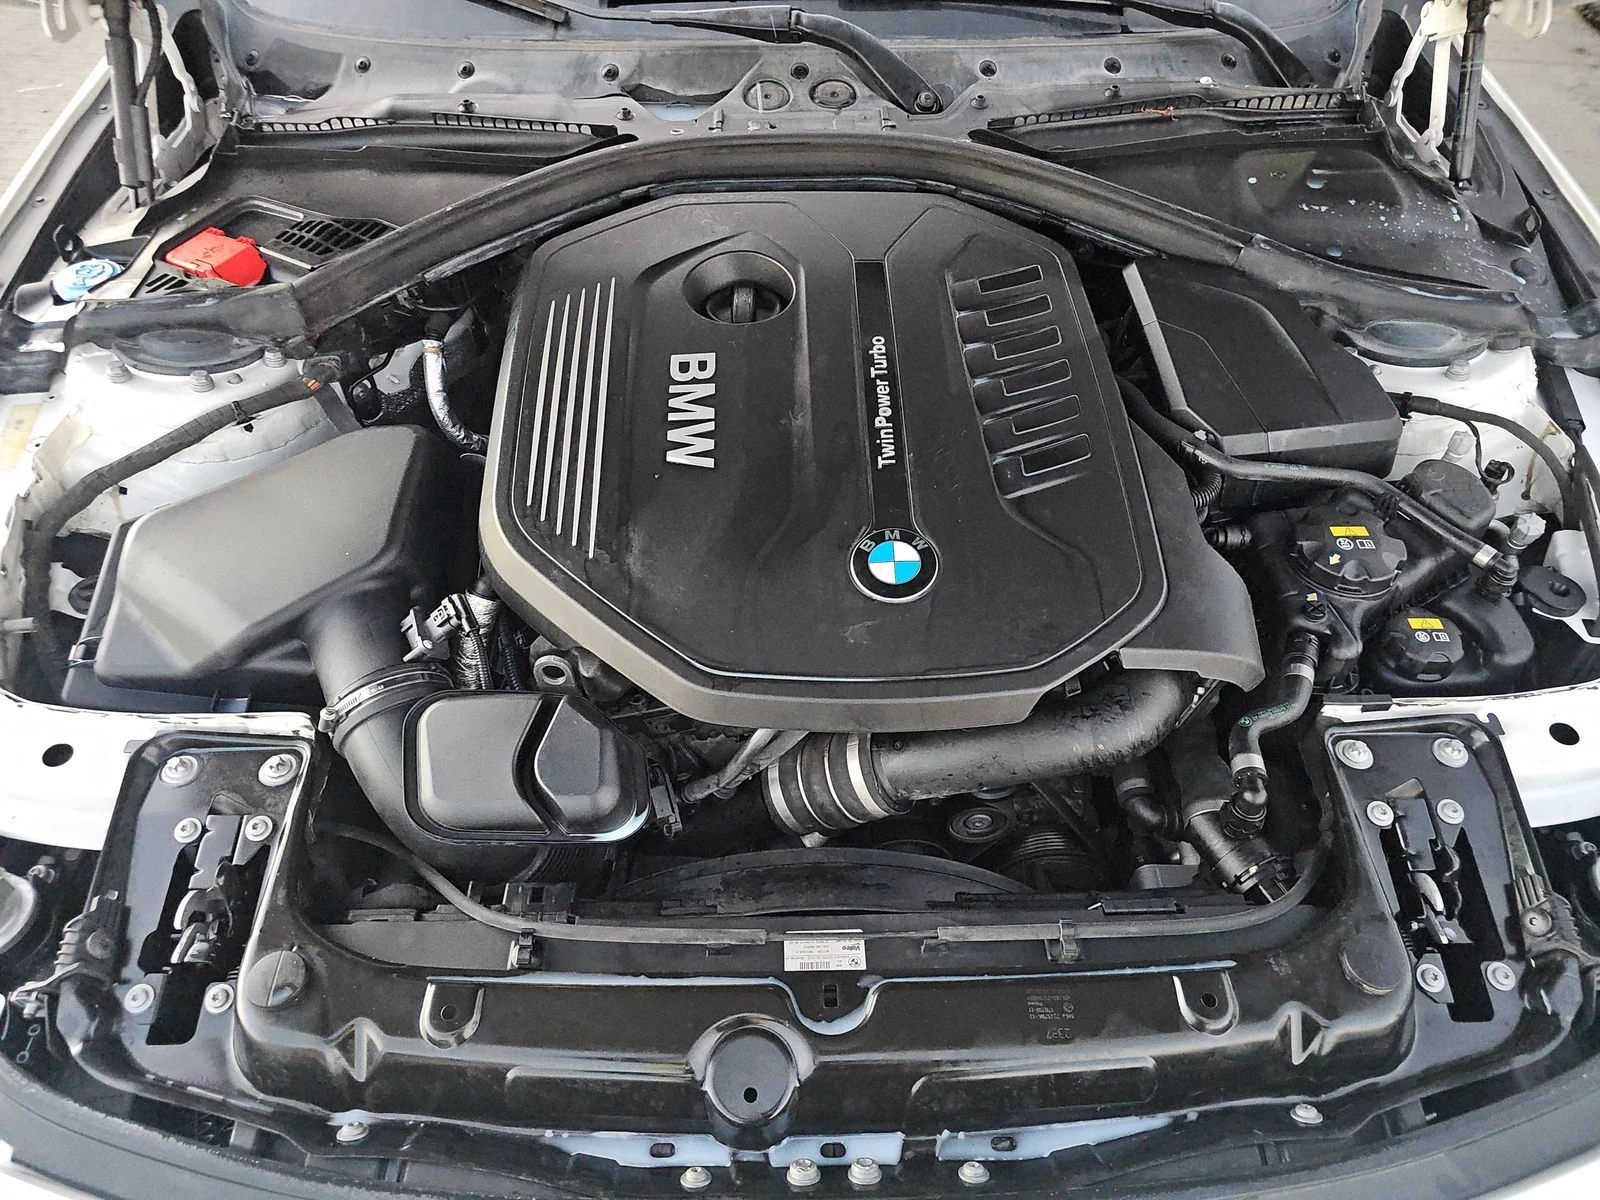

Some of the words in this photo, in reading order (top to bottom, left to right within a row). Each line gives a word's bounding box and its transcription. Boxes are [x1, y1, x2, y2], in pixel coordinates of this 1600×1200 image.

[869, 335, 888, 379] Turbo
[666, 352, 716, 469] BMW
[874, 378, 896, 470] TwinPower
[859, 529, 929, 553] BMW
[841, 944, 861, 953] Valeo
